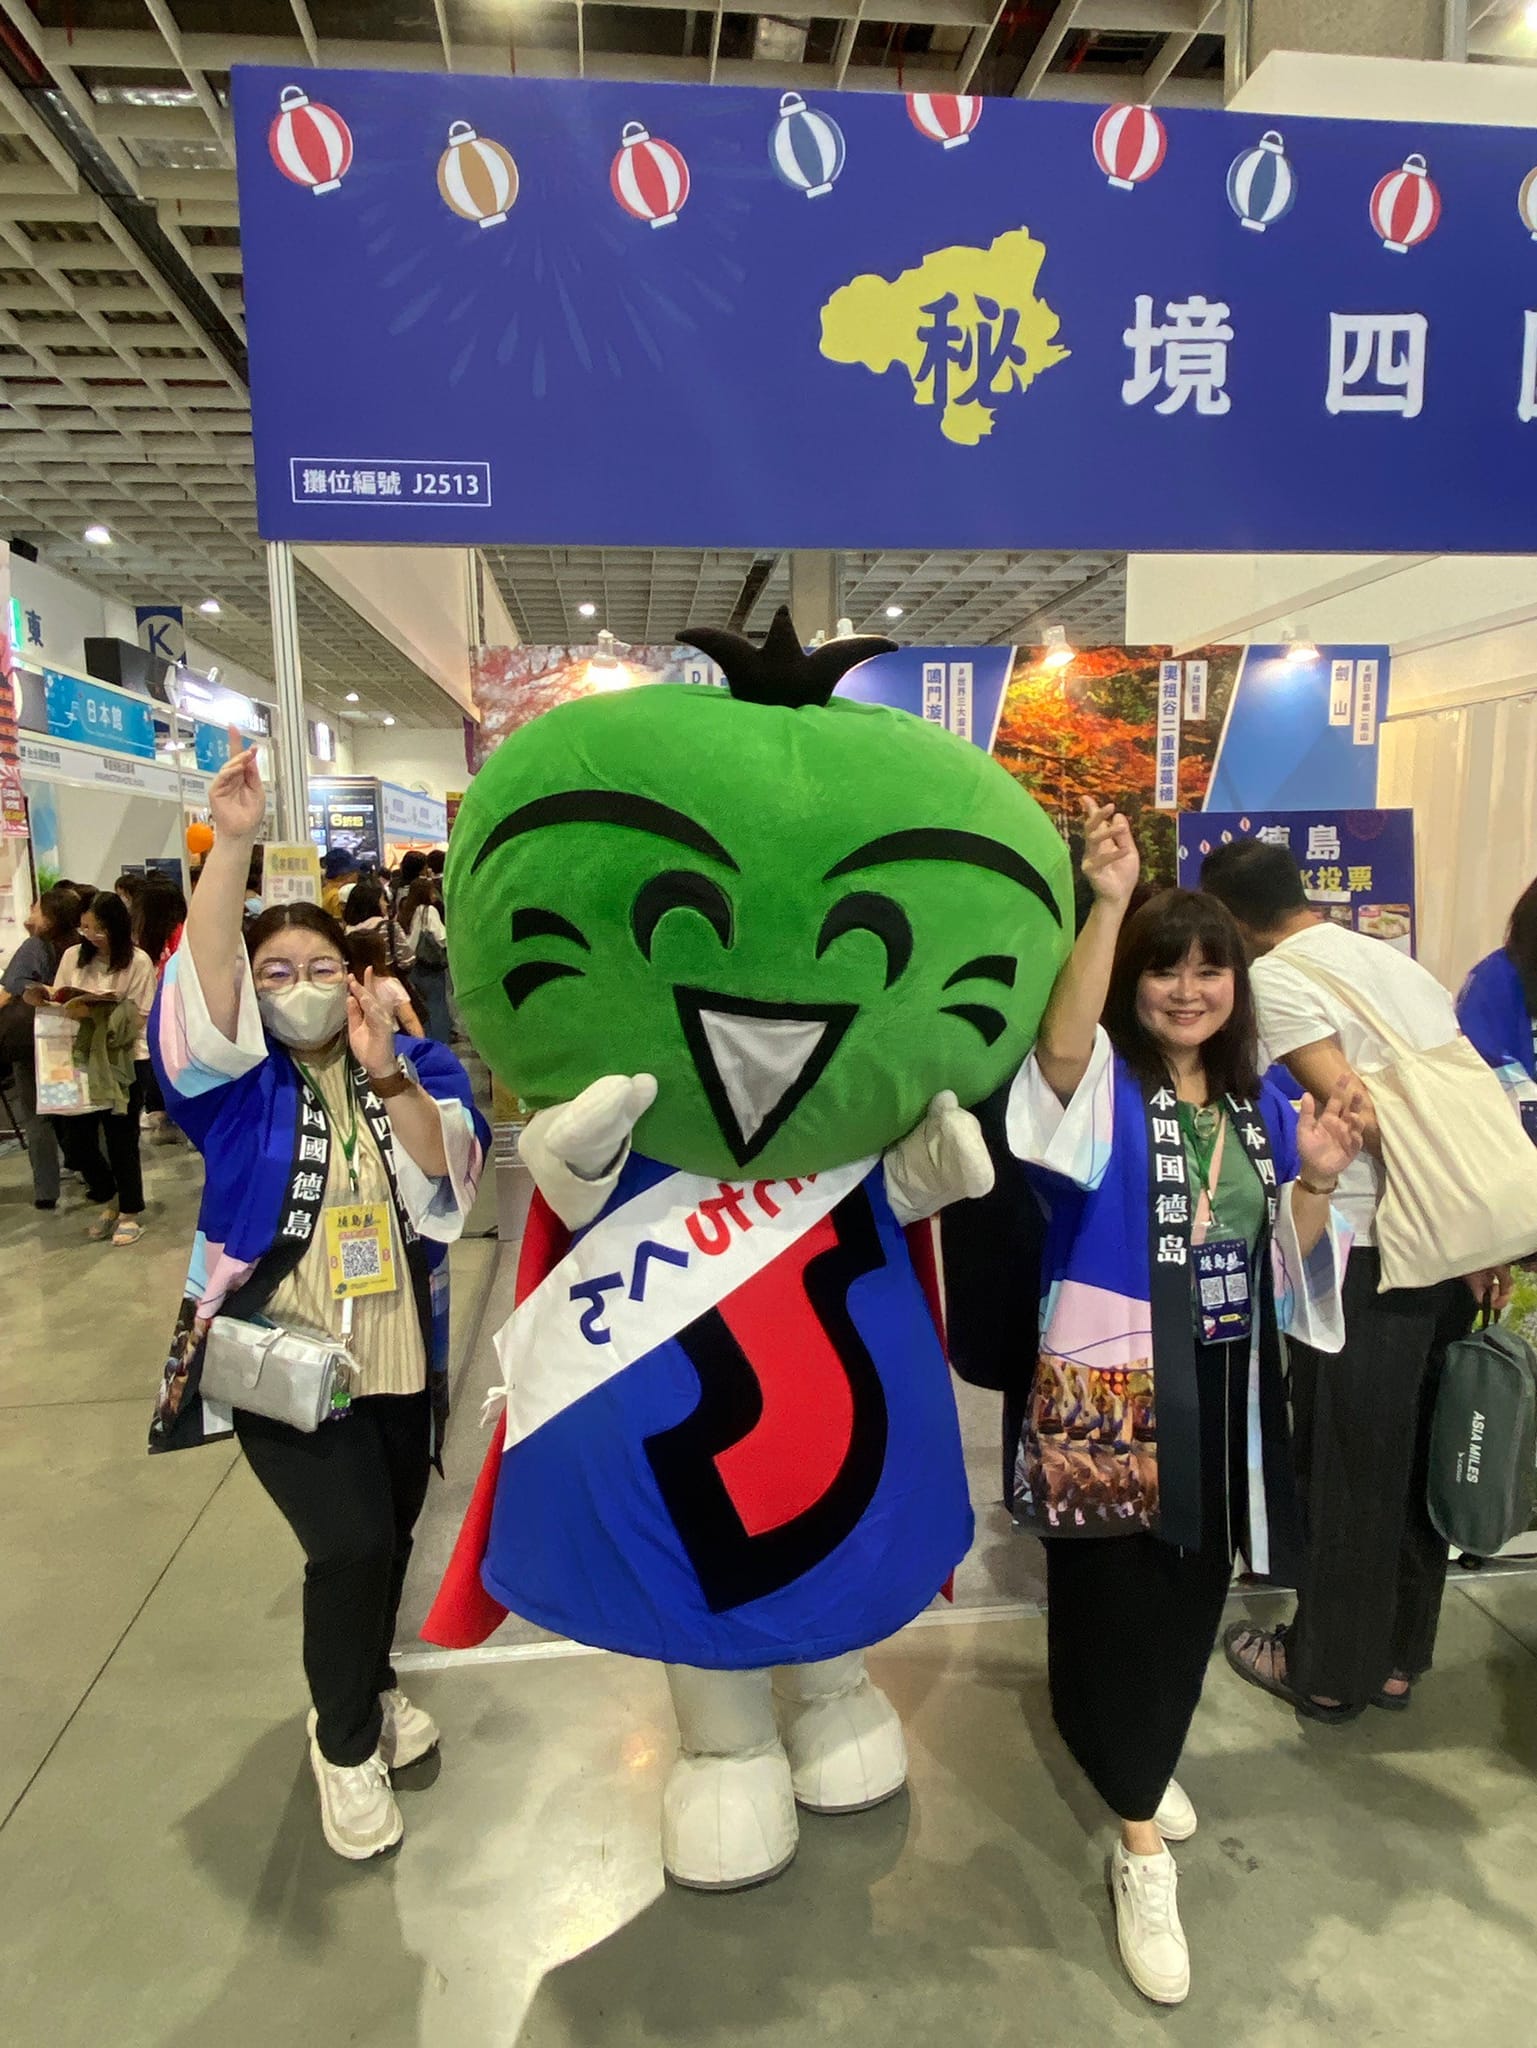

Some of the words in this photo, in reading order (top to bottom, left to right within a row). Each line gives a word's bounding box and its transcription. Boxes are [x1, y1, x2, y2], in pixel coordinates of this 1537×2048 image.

[915, 290, 1537, 423] 秘境四
[302, 468, 402, 496] 攤位編號
[412, 473, 479, 496] J2513
[148, 623, 174, 656] K
[86, 698, 123, 732] 日本館
[926, 668, 942, 728] 鳴門漩
[1472, 1410, 1486, 1447] ASIA
[1466, 1446, 1482, 1484] MILES
